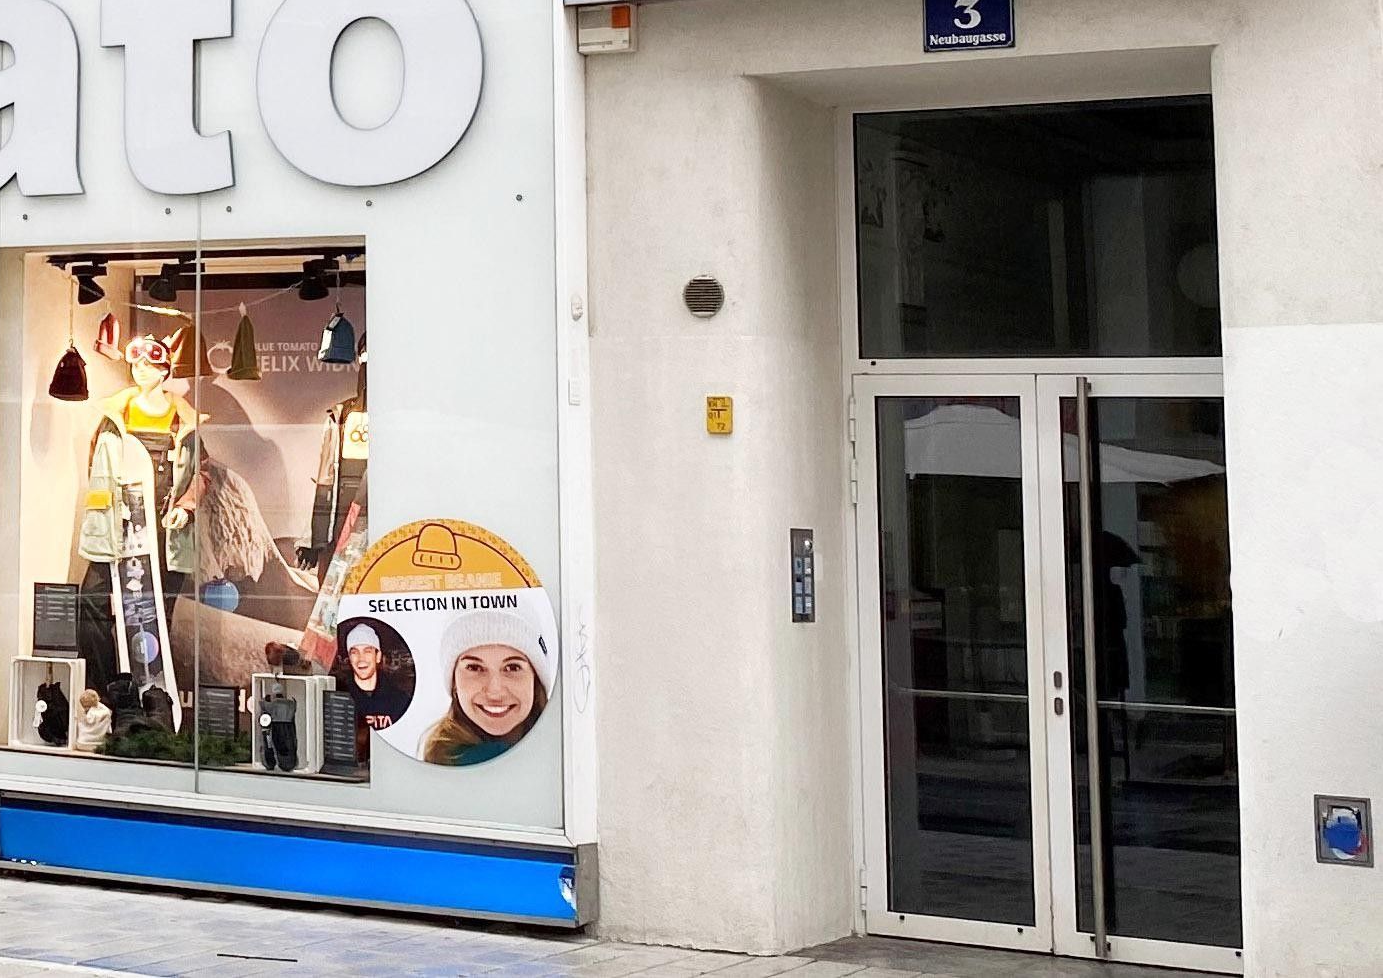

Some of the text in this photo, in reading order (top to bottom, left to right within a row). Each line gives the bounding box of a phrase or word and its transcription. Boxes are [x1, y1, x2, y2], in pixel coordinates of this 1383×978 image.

[929, 32, 1006, 46] Neubaugasse
[278, 341, 319, 352] TOMATO
[368, 594, 518, 613] SELECTION IN TOWN
